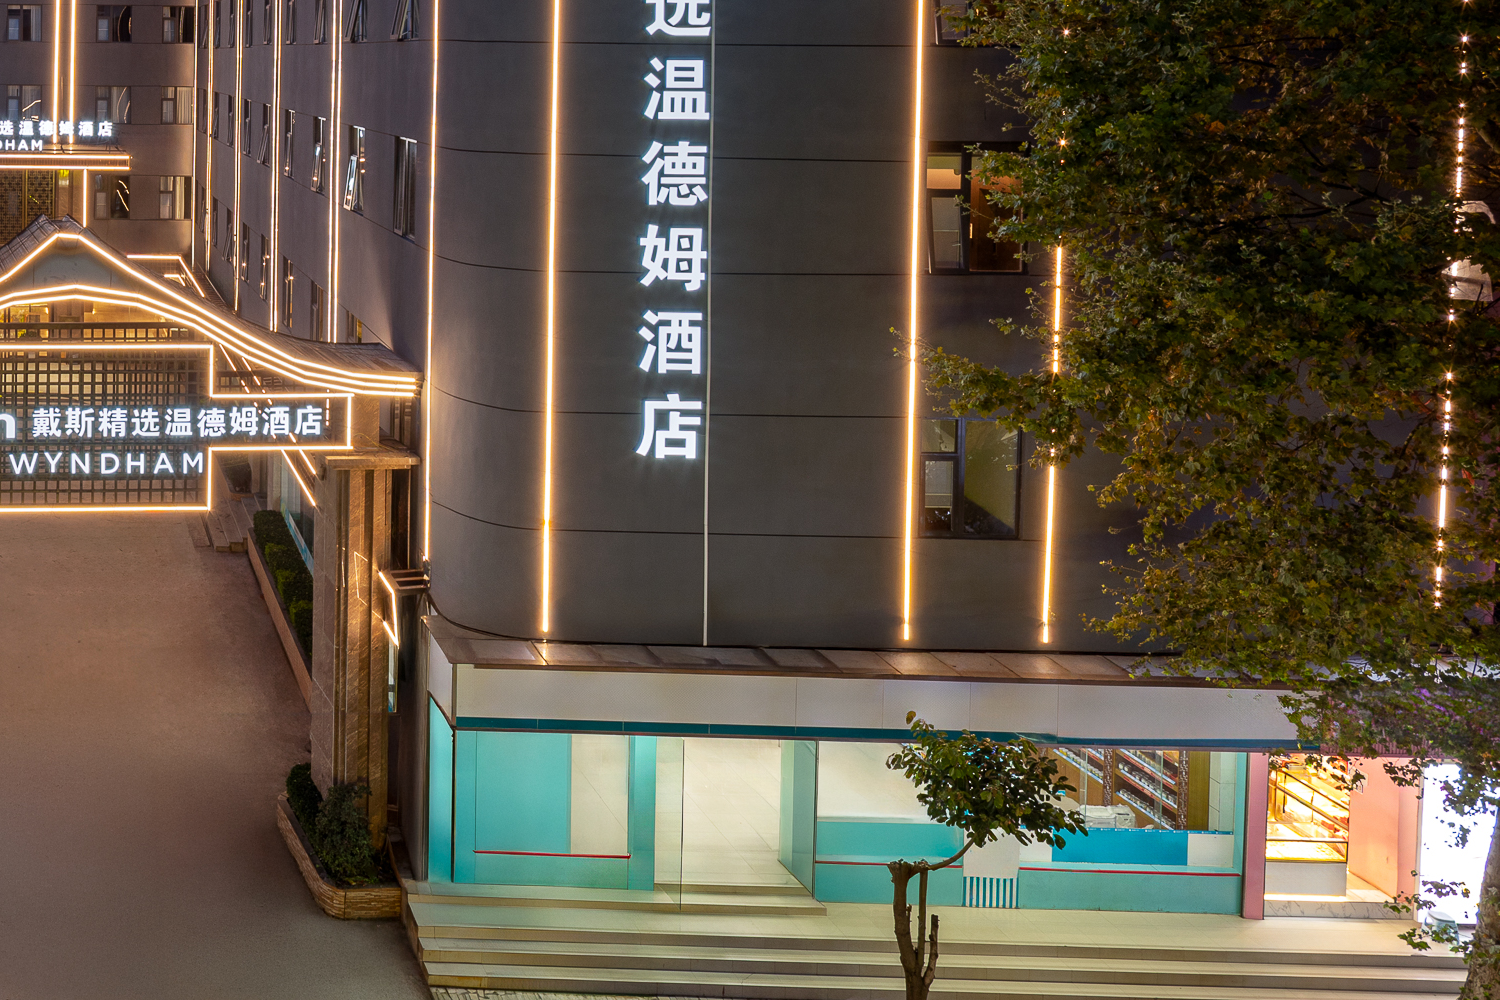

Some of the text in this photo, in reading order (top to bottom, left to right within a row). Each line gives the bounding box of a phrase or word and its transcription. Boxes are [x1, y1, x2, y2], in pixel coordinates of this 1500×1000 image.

[31, 405, 323, 438] 戴斯精选温德姆酒店
[9, 451, 204, 475] WYNDHAM
